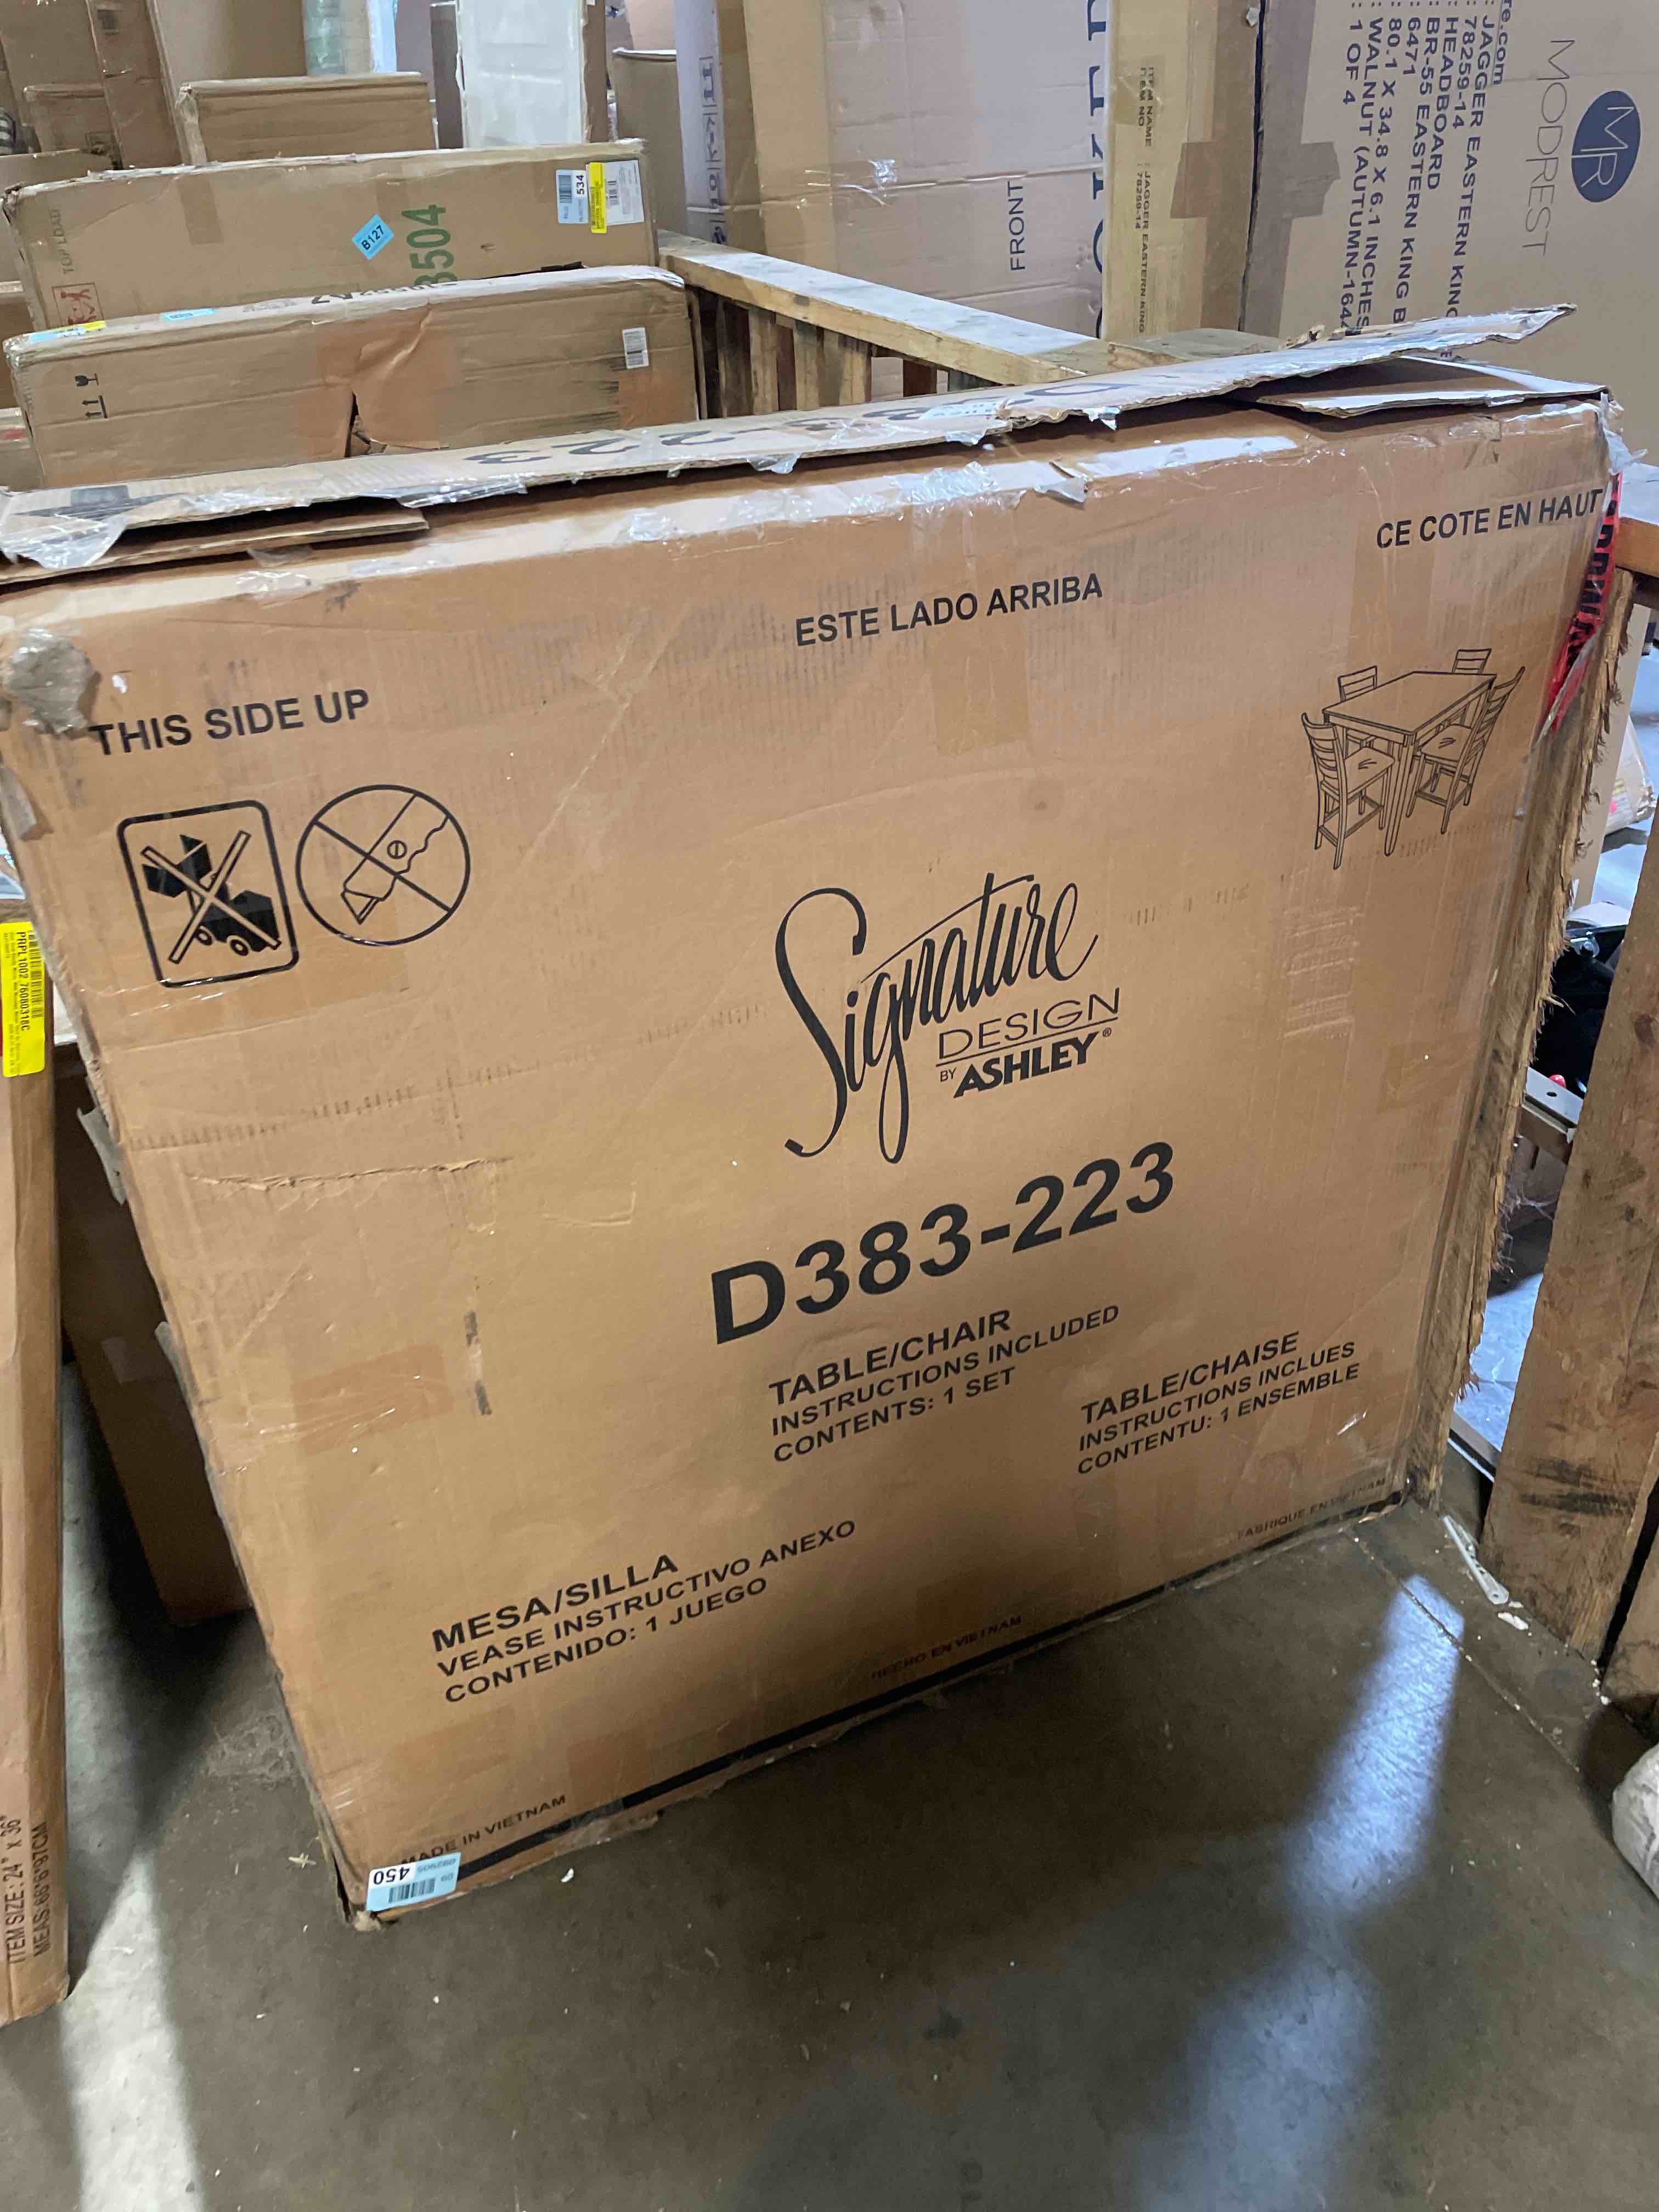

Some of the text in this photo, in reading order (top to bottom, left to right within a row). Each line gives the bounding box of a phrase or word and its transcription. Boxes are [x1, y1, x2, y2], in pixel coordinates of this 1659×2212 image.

[1342, 20, 1362, 104] 1 OF 4
[1359, 17, 1384, 136] WALNUT
[1402, 17, 1421, 76] 6471
[1419, 17, 1440, 96] BR-55
[1452, 17, 1477, 128] 78259-14
[1470, 16, 1496, 127] JAGGER
[1144, 106, 1153, 148] NAME
[1427, 17, 1459, 190] HEADBOARD
[575, 174, 585, 195] 534
[1355, 17, 1402, 329] 80.1 X 34.8 X 6.1 INCHES
[1403, 105, 1430, 228] EASTERN
[1522, 39, 1575, 257] MODREST
[360, 224, 385, 252] B127
[1007, 180, 1025, 272] FRONT
[1141, 171, 1151, 230] JAGGER
[1453, 139, 1481, 256] EASTERN
[57, 238, 74, 274] TOP
[1139, 233, 1149, 297] EASTERN
[1393, 237, 1414, 298] KING
[1137, 300, 1146, 334] KING
[1376, 488, 1602, 549] CE COTE EN HAUT
[795, 573, 1103, 646] ESTE LADO ARRIBA
[88, 689, 370, 755] THIS SIDE UP
[18, 957, 30, 979] 1002
[775, 872, 1099, 1164] Signature
[939, 987, 1120, 1059] DESIGN
[940, 1067, 956, 1084] BY
[711, 1141, 1174, 1345] D383-223
[769, 1309, 1011, 1406] TABLE/CHAIR
[772, 1304, 1120, 1436] INSTRUCTIONS INCLUDED
[1079, 1341, 1356, 1452] INSTRUCTIONS INCLUES
[1081, 1330, 1300, 1425] TABLE/CHAISE
[774, 1367, 1016, 1463] CONTENTS: 1 SET
[1077, 1362, 1361, 1476] CONTENTU: 1 ENSEMBLE
[1330, 1479, 1385, 1506] VTNAM
[431, 1553, 679, 1653] MESA/SILLA
[437, 1519, 856, 1678] VEASE INSTRUCTIVO ANEXO
[955, 1615, 1023, 1647] VIETNAM
[444, 1577, 768, 1704] CONTENIDO: 1 JUEGO
[462, 1830, 481, 1846] IN
[484, 1794, 566, 1835] VIETNAM
[374, 1866, 410, 1886] 450
[6, 1924, 26, 1965] ITEM
